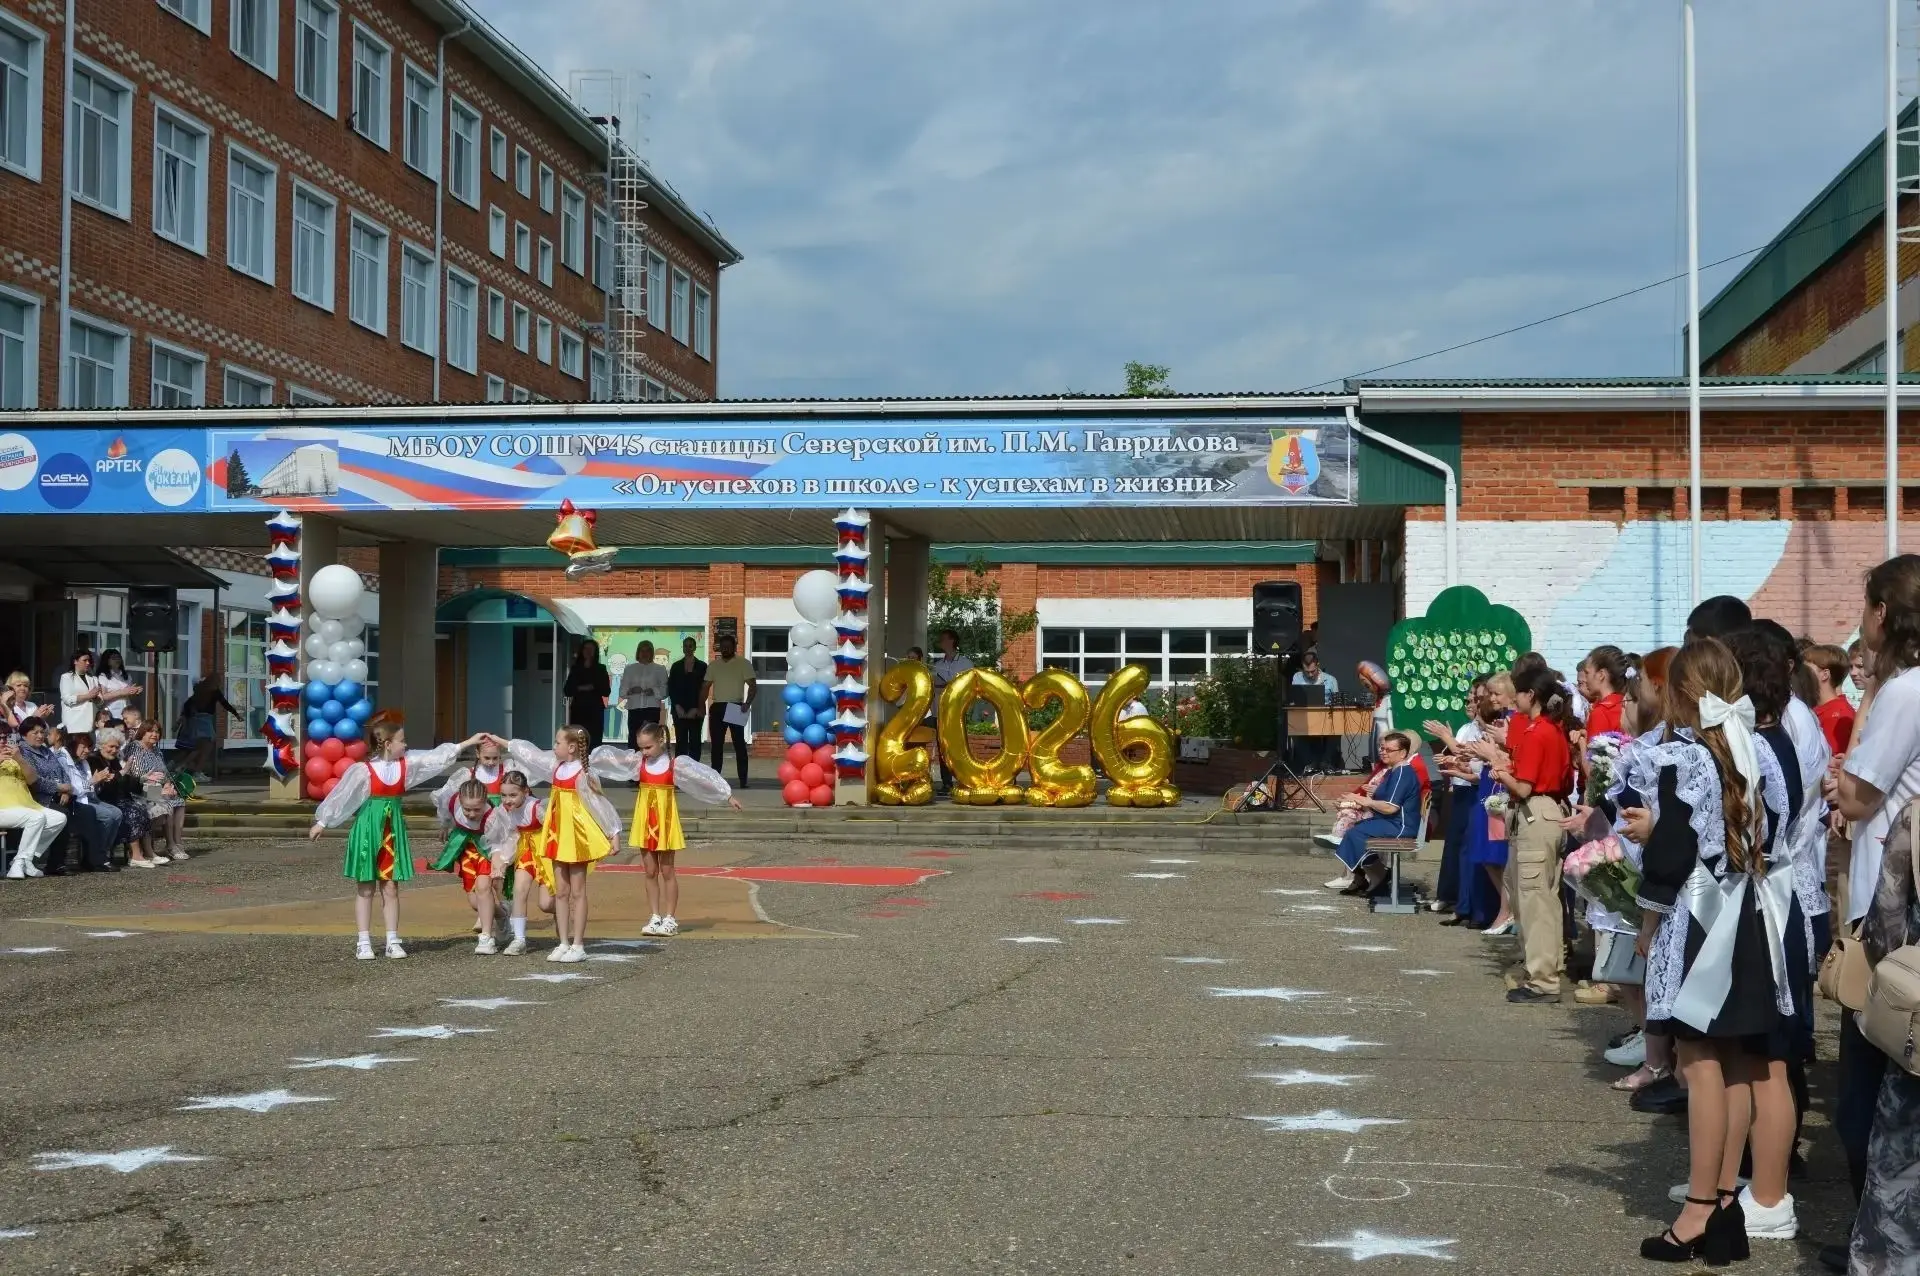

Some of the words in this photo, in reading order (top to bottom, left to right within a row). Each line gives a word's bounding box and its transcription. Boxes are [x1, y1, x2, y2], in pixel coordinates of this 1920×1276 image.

[387, 435, 486, 458] МБОУ
[490, 434, 573, 456] СОШ
[579, 434, 645, 456] №45
[650, 439, 777, 458] станицы
[782, 432, 941, 461] Северской
[946, 437, 996, 454] им.
[1001, 430, 1077, 453] П.М.
[1083, 430, 1239, 459] Гаврилова
[96, 460, 142, 473] АРТЕК
[156, 473, 190, 485] ОКЕАН
[612, 473, 678, 495] «От
[681, 478, 797, 501] успехов
[802, 479, 821, 494] в
[825, 478, 920, 495] школе
[940, 478, 962, 494] к
[963, 477, 1086, 501] успехам
[1091, 477, 1109, 493] в
[1114, 477, 1238, 494] жизни»
[873, 659, 1176, 800] 2026
